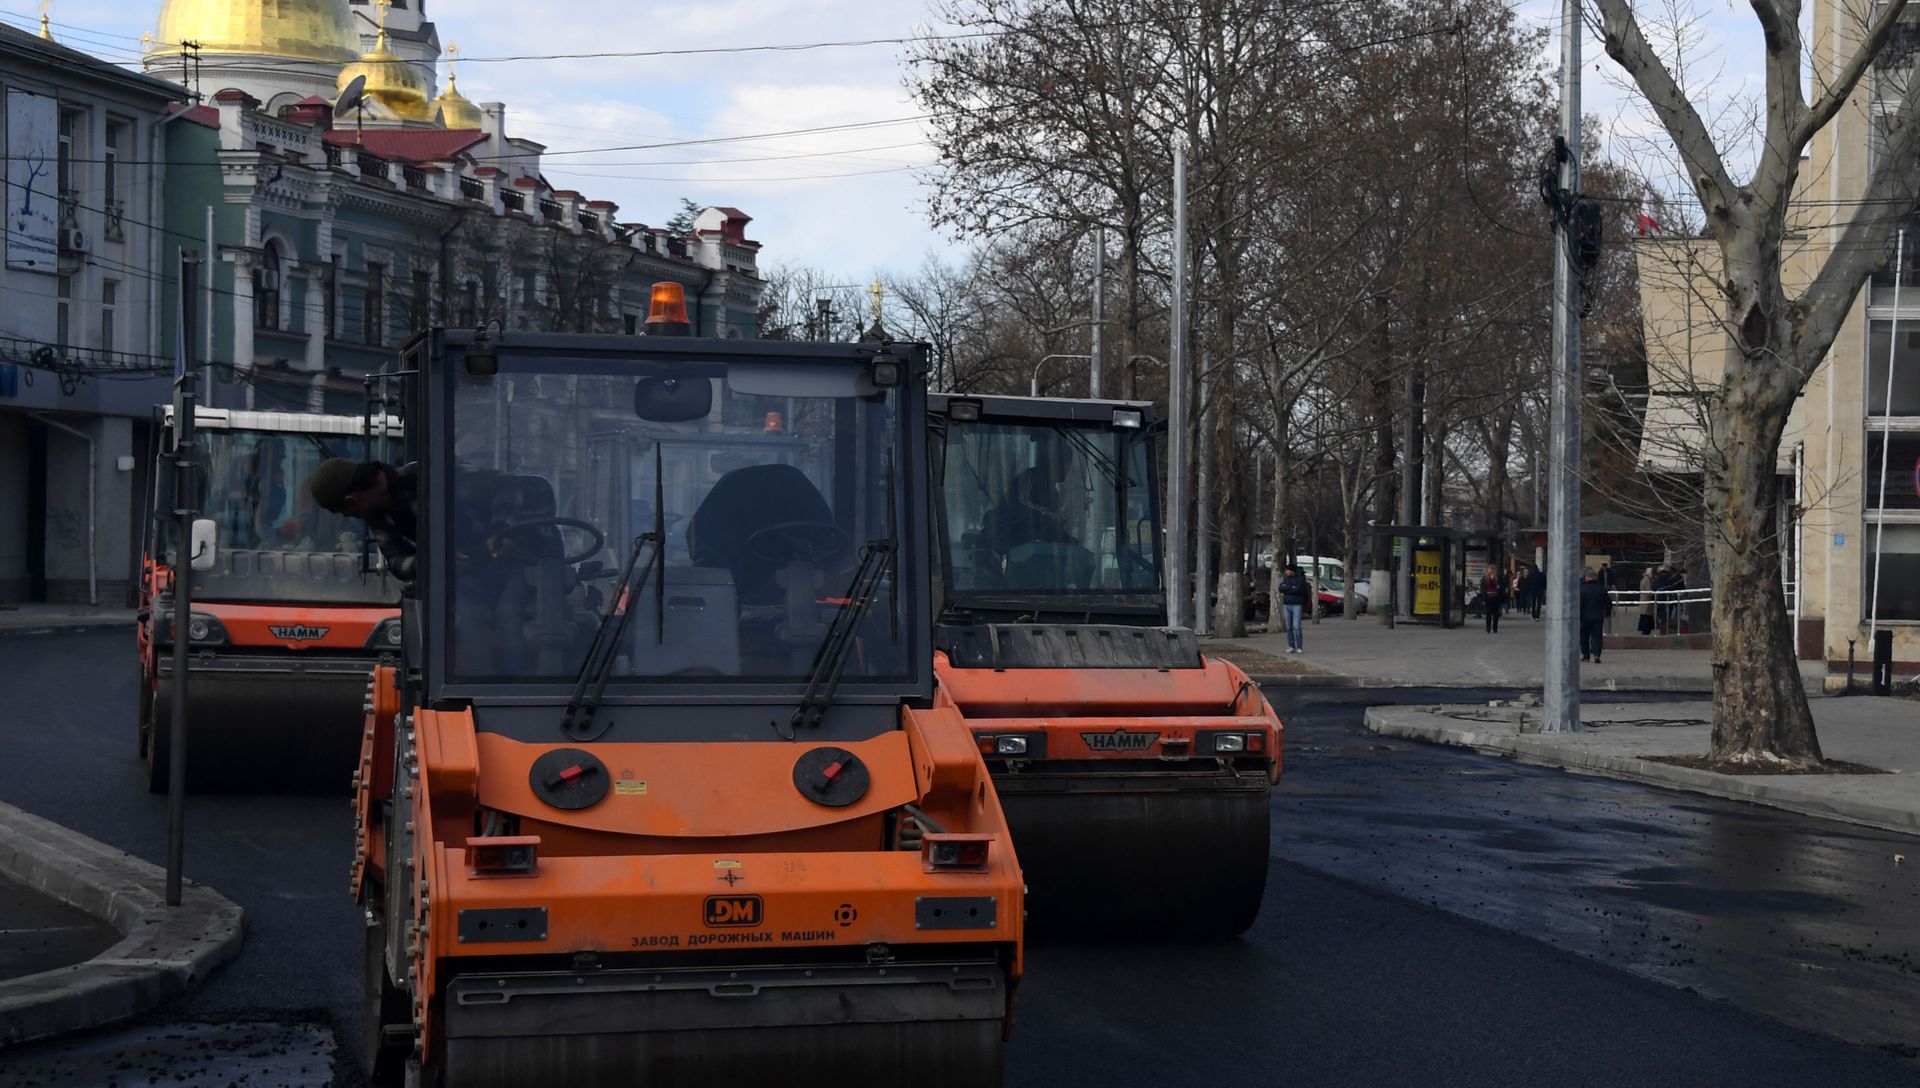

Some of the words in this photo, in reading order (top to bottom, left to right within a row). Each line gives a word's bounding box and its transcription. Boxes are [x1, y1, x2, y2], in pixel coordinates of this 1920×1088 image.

[279, 628, 320, 638] HAMM
[1093, 734, 1147, 748] HAMM
[631, 935, 680, 947] ЗАВОД
[687, 932, 773, 946] ДОРОЖНЫХ
[781, 930, 836, 942] МАШИН
